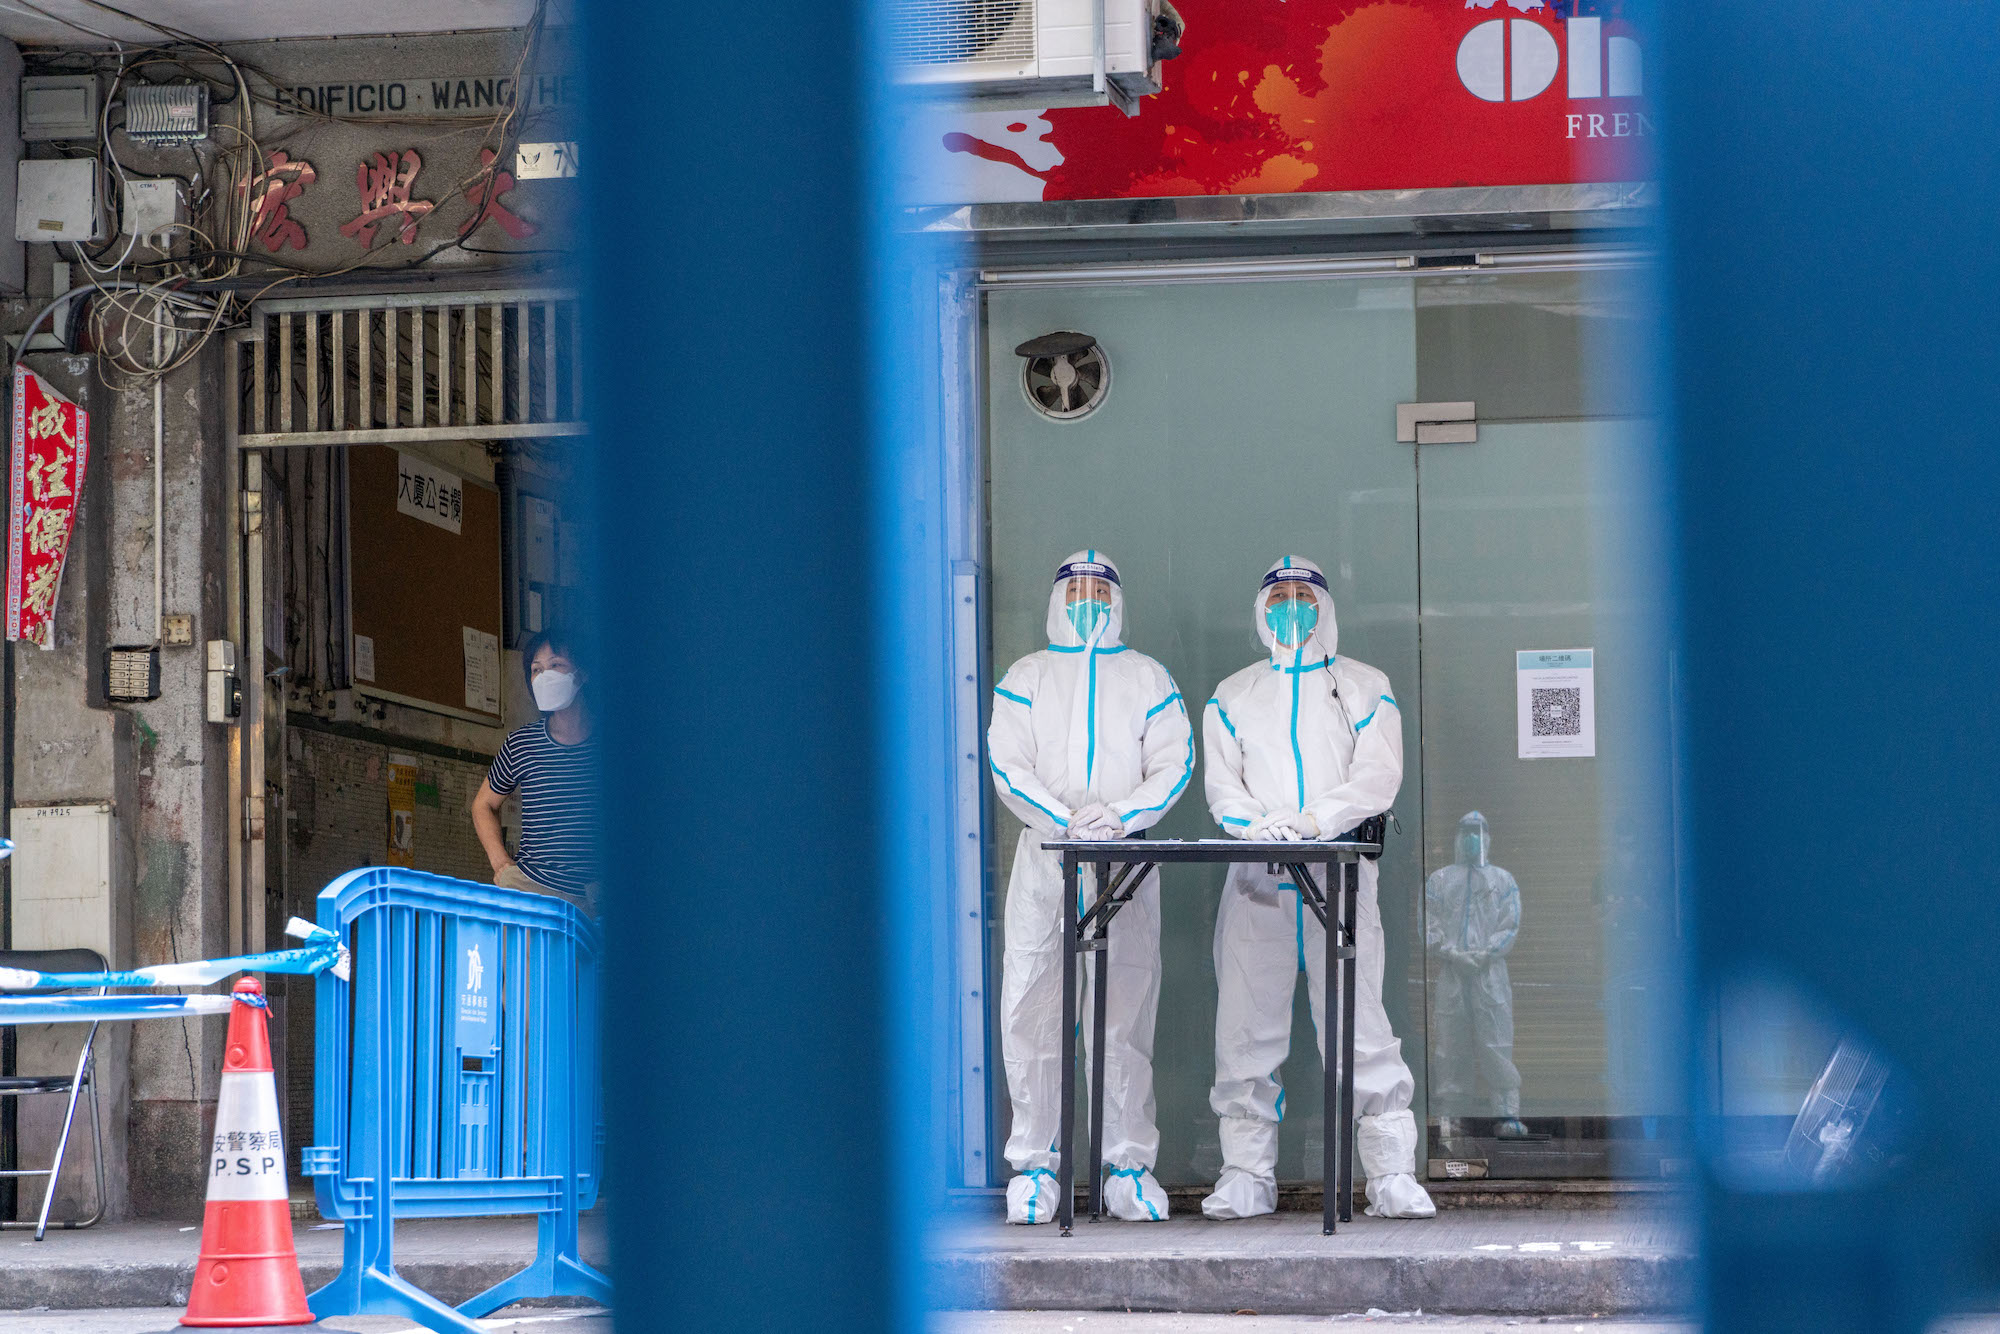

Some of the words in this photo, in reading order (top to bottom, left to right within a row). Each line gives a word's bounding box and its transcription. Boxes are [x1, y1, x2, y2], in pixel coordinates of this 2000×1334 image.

[275, 83, 407, 116] EDIFICIO
[553, 149, 564, 171] 7
[1292, 569, 1310, 577] Shield
